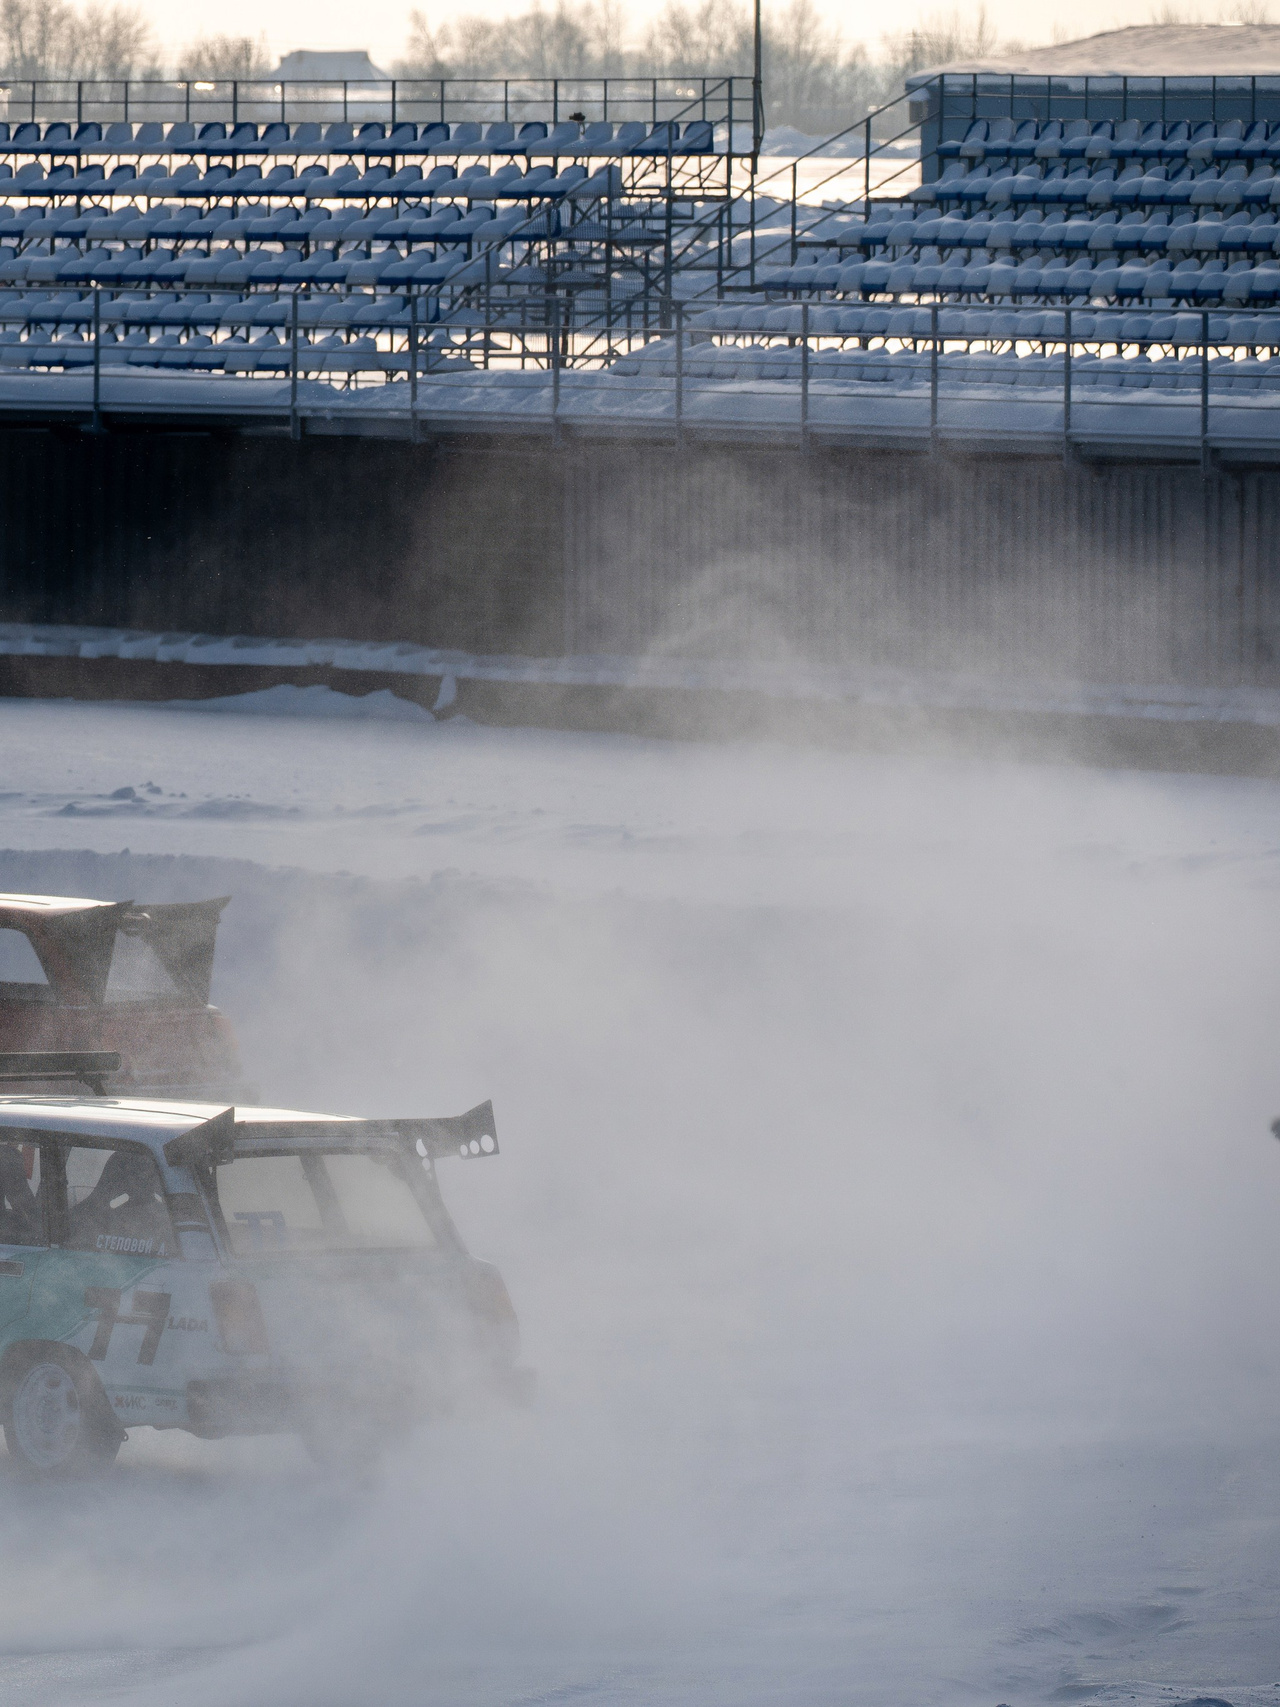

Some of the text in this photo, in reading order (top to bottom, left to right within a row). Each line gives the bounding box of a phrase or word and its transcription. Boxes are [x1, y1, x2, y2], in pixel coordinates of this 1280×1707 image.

[96, 1234, 155, 1254] СТЕПОВОЙ
[83, 1286, 173, 1366] 77
[168, 1316, 209, 1332] LADA
